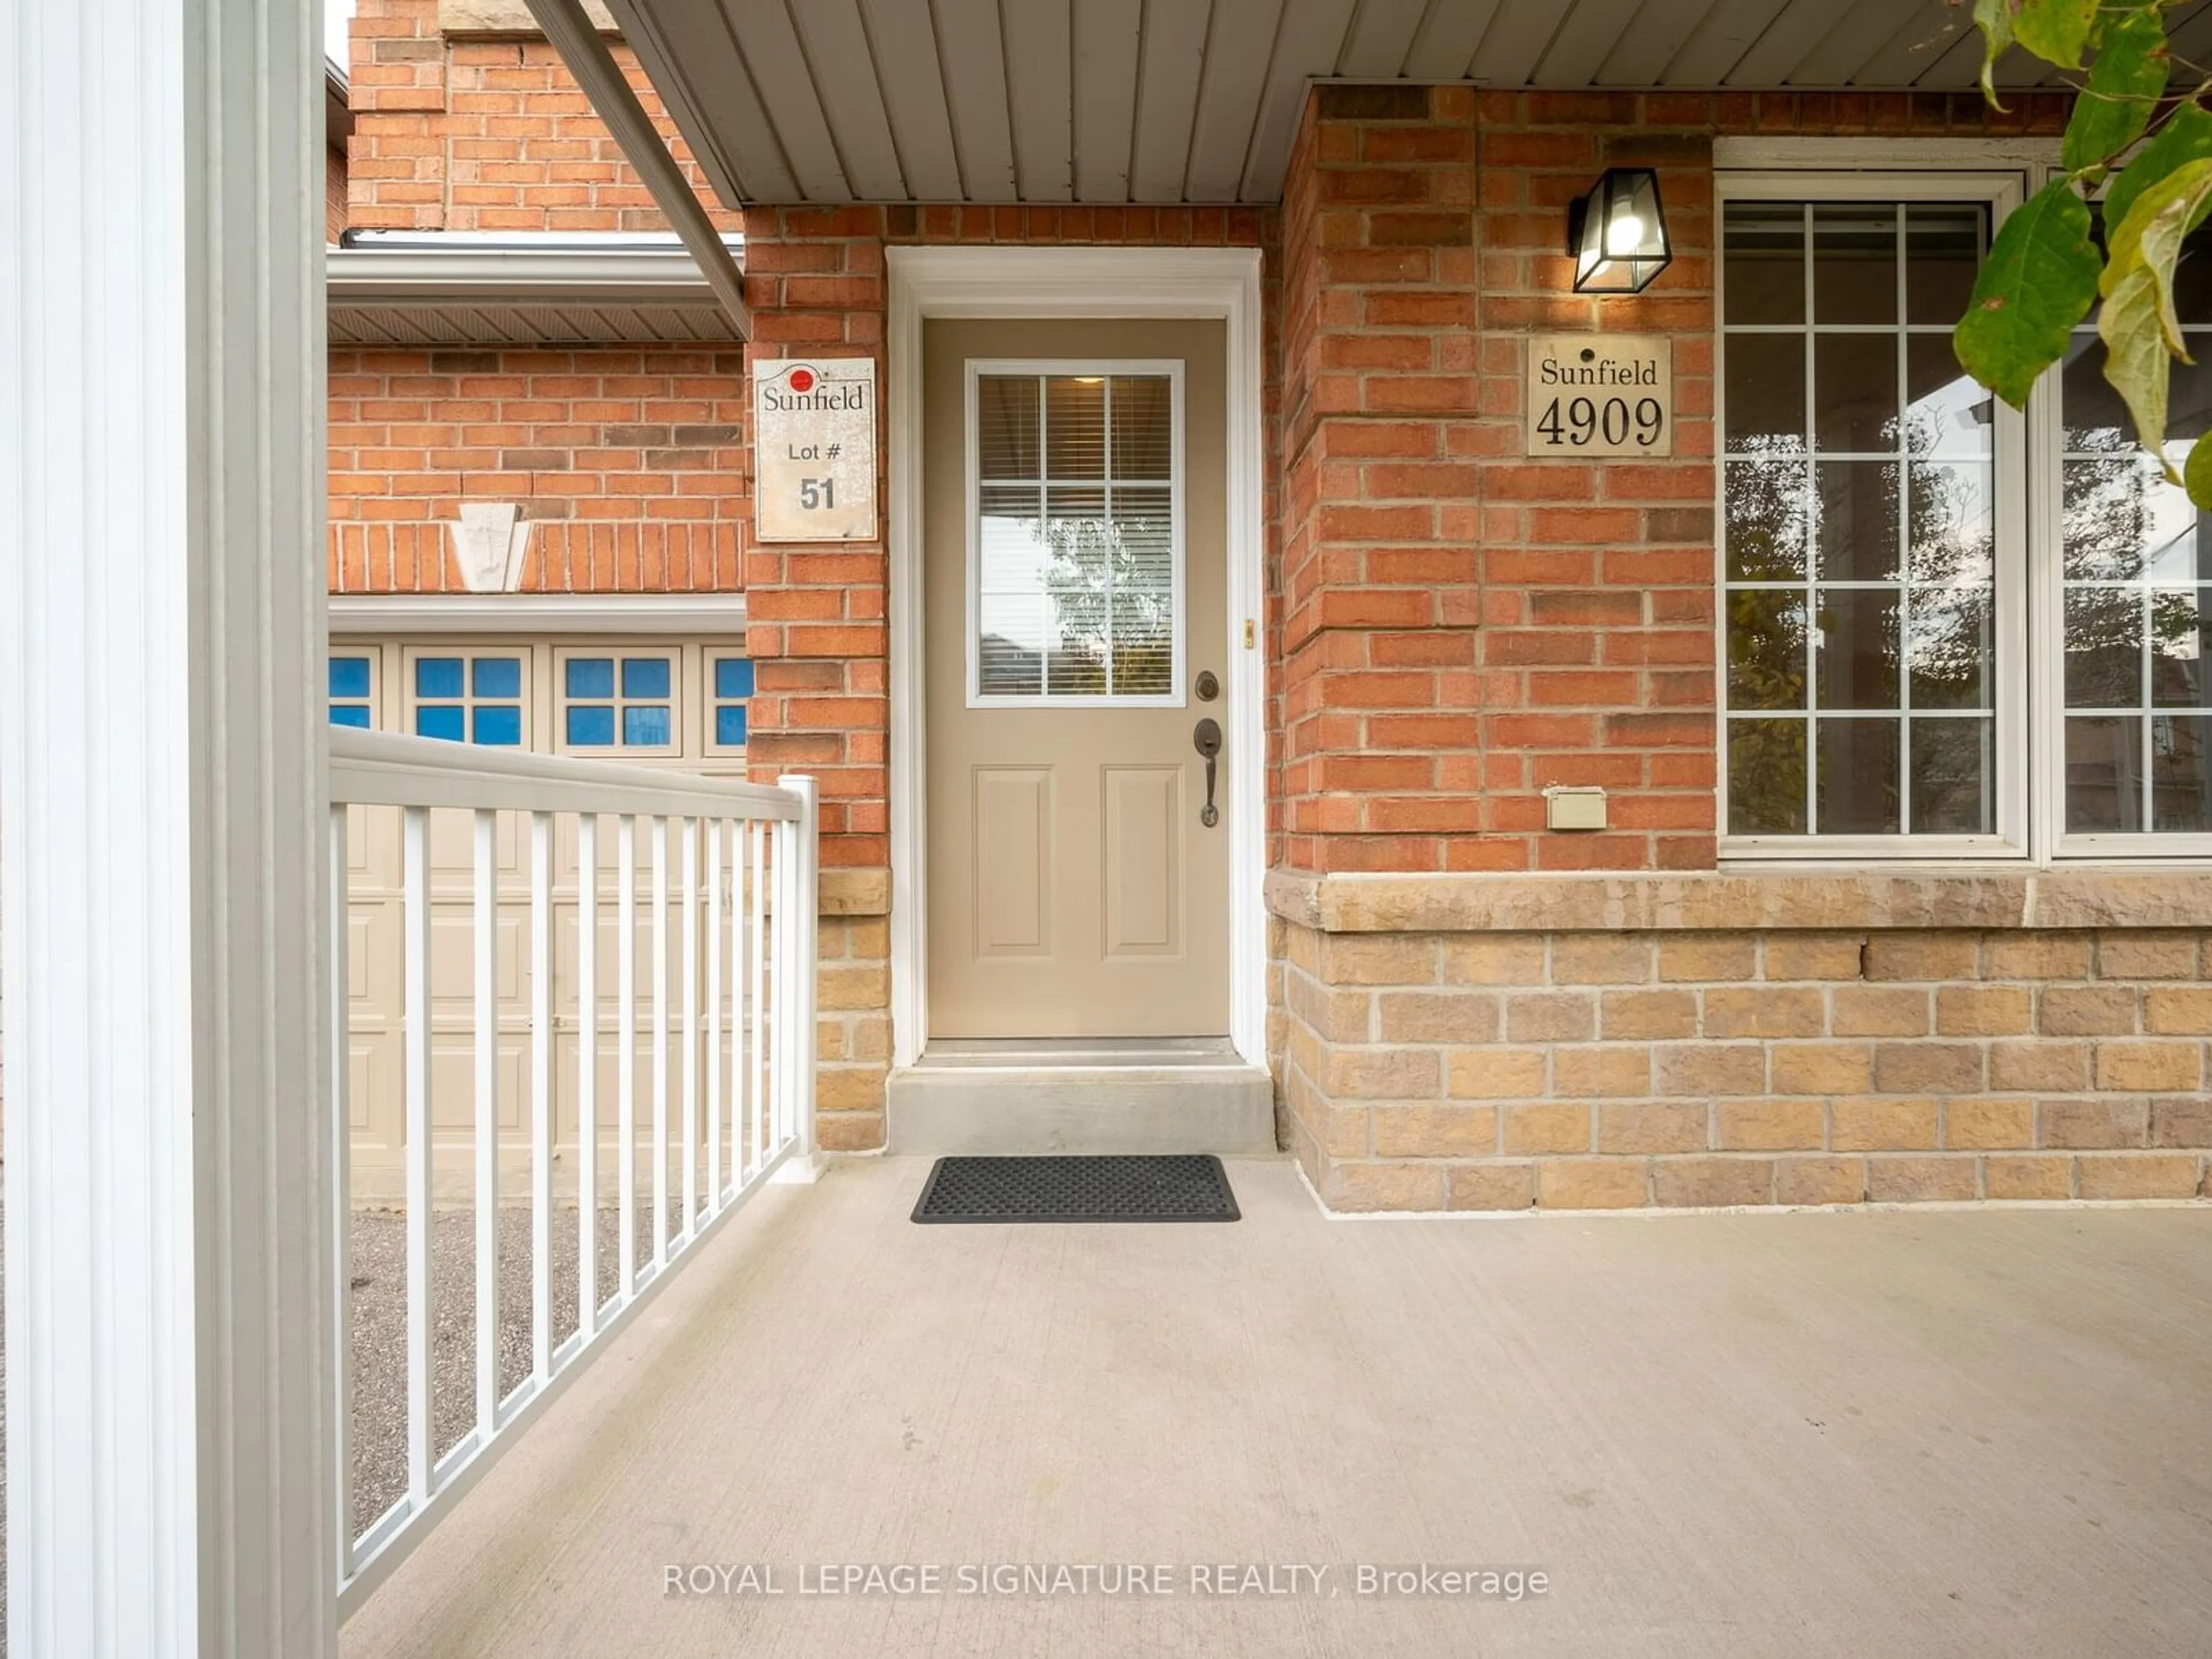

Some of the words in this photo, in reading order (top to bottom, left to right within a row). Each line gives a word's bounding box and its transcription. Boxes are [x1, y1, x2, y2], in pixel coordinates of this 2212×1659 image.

[1541, 358, 1658, 385] Sunfield
[764, 385, 863, 411] Sunfield
[1536, 396, 1663, 446] 4909
[789, 444, 819, 460] Lot
[827, 443, 842, 460] #
[801, 478, 834, 509] 51
